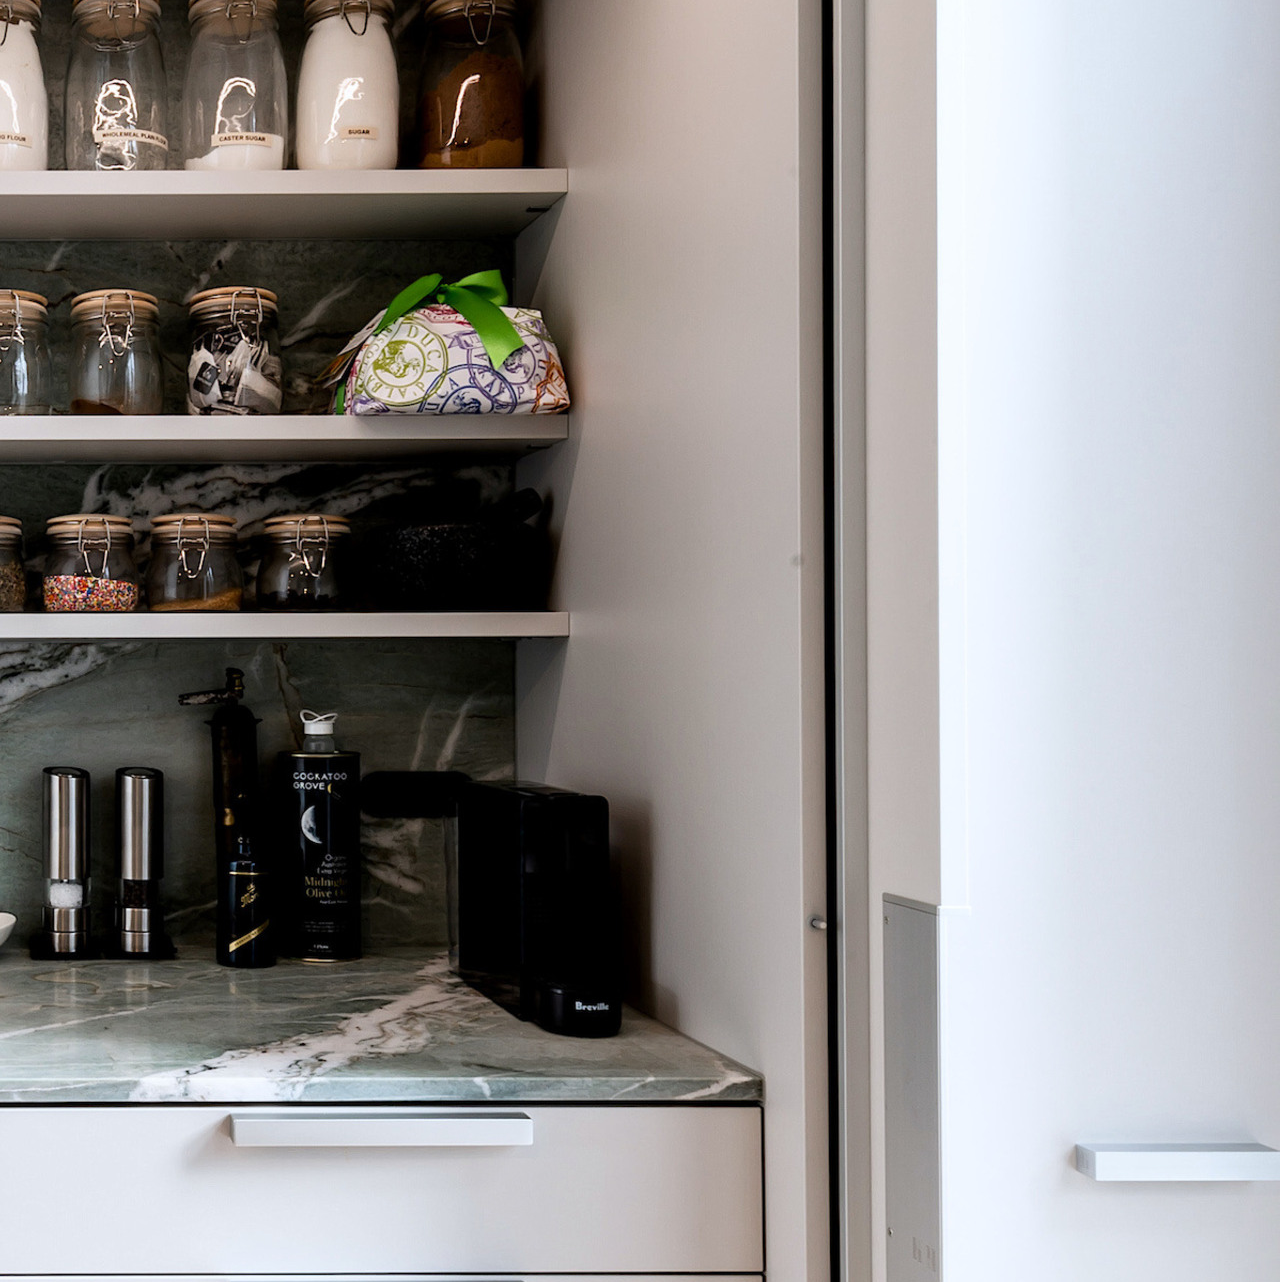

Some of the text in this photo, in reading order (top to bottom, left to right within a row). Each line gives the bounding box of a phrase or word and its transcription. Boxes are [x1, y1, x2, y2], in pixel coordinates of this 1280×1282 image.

[7, 134, 27, 143] FLOUR
[140, 132, 155, 141] PLAIN
[406, 324, 441, 373] DUCA
[292, 771, 348, 781] COCKATOO
[292, 781, 326, 790] GROVE
[305, 887, 333, 898] Olive
[575, 1001, 609, 1011] Breville
